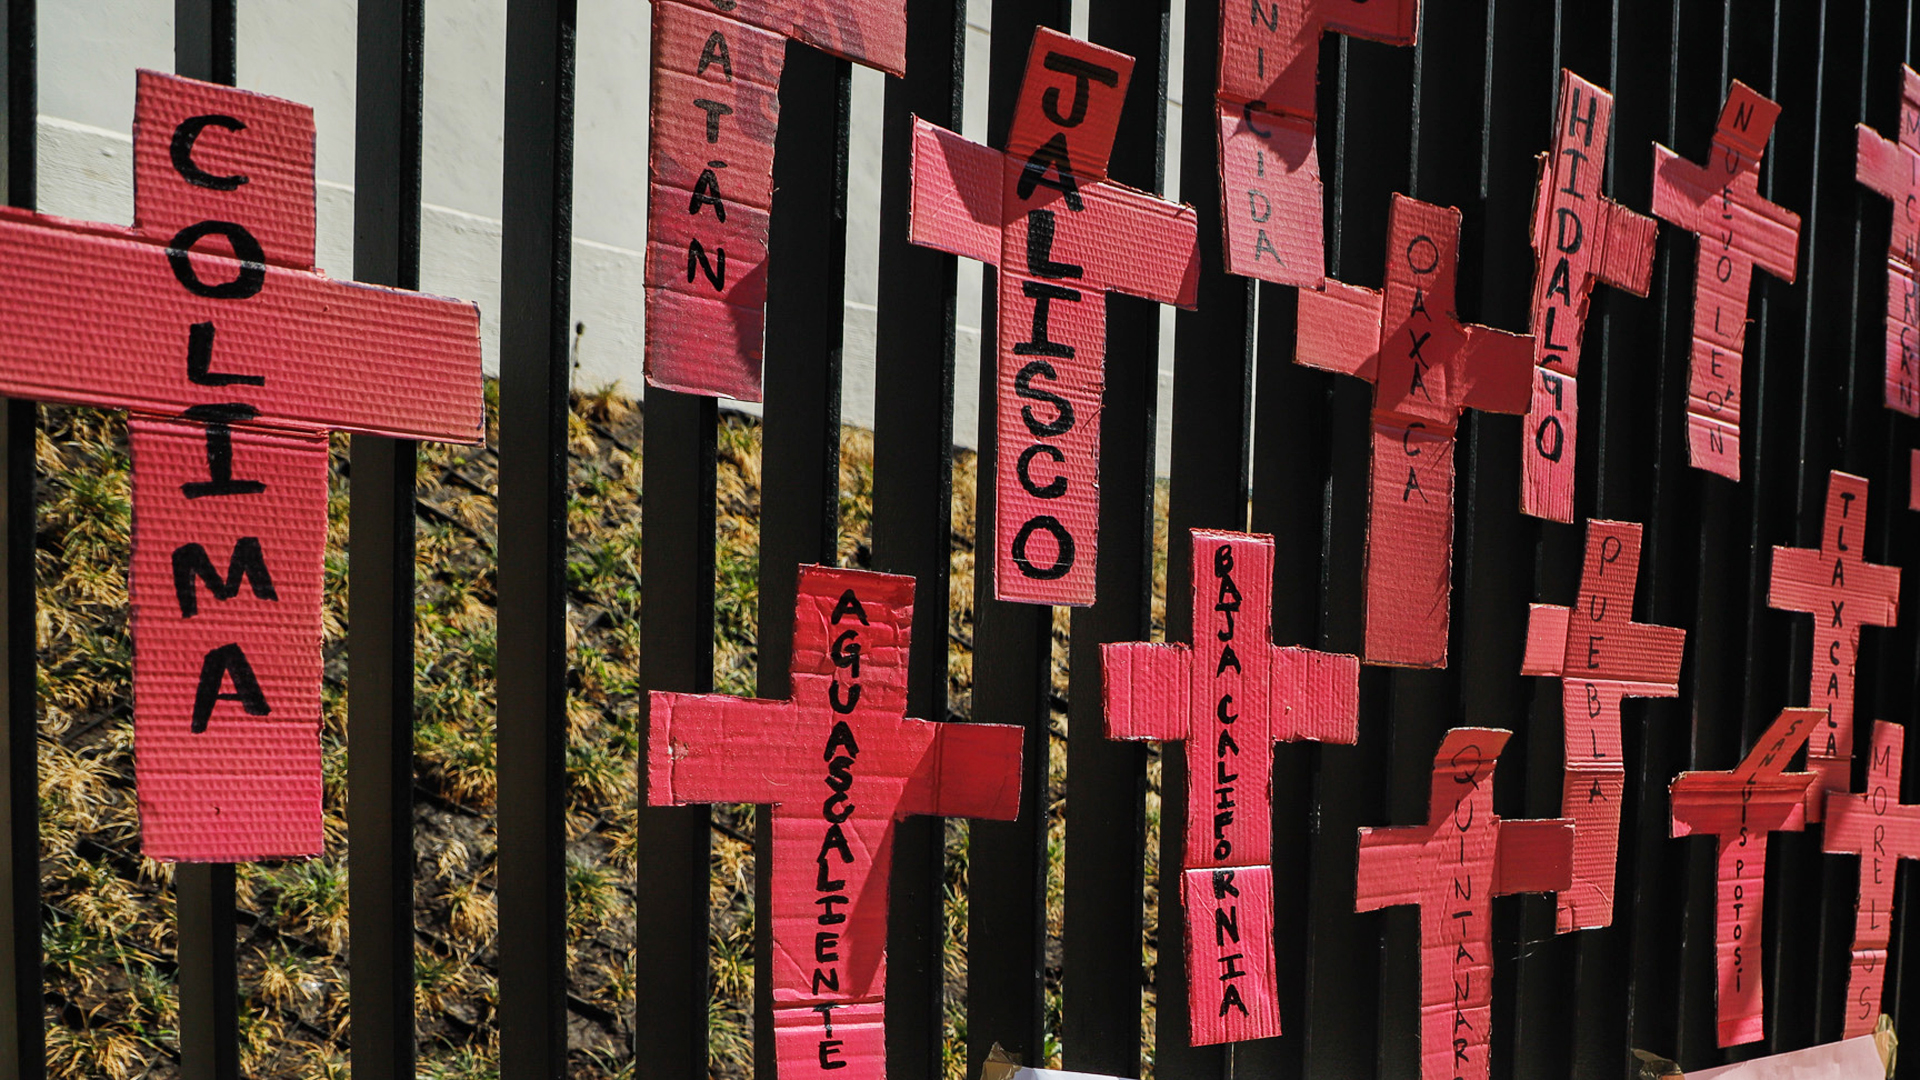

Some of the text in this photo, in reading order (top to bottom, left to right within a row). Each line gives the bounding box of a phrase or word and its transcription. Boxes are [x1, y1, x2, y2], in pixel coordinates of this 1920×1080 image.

[687, 0, 737, 292] ATÁN
[1535, 87, 1598, 463] HIDALGO
[167, 114, 277, 734] COLIMA
[1010, 50, 1119, 581] JALISCO
[1403, 235, 1439, 503] OAXACA
[1211, 545, 1250, 1019] BAJA CALIFORNIA
[1586, 535, 1622, 804] PUEBLA
[1826, 492, 1855, 755] TLAXCALA
[811, 589, 869, 1070] AGUASCALIENTE
[1858, 746, 1891, 1020] MORELOS
